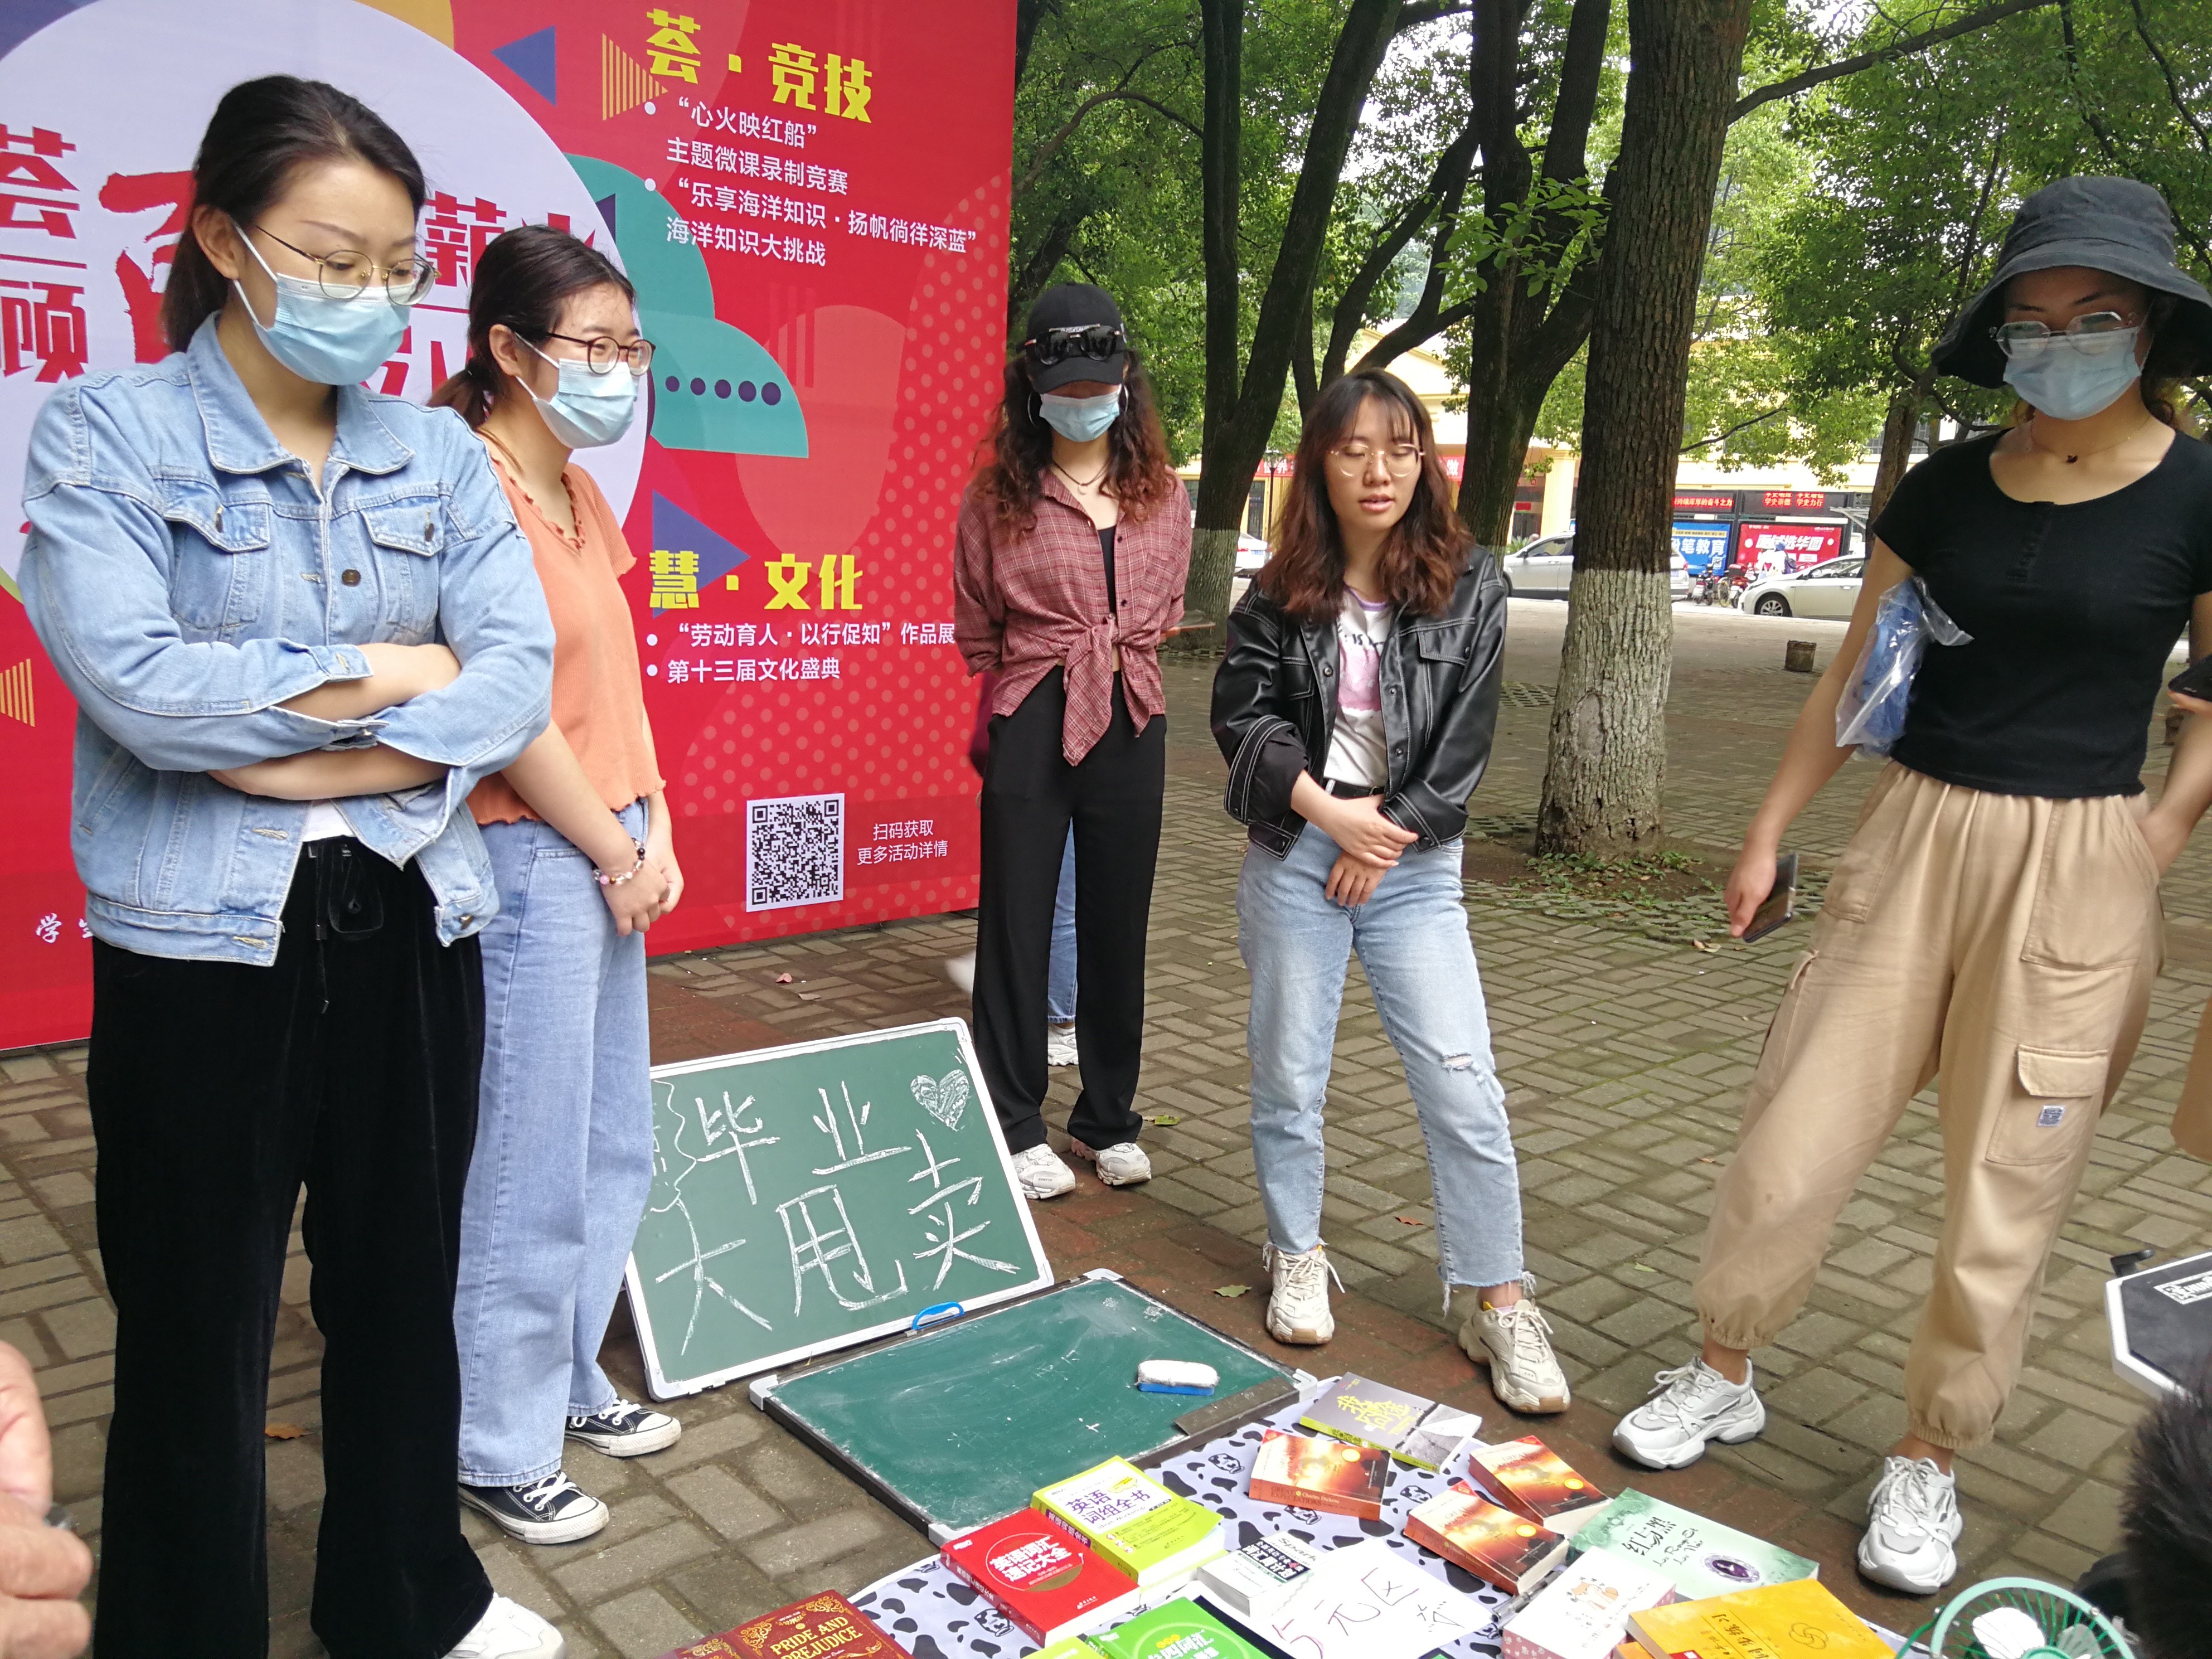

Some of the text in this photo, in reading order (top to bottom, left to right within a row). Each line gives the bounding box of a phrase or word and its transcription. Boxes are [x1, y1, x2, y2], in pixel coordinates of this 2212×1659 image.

[647, 8, 872, 123] 荟·竞技
[678, 97, 817, 149] “心火映红船”
[667, 137, 848, 195] 主题微课录制竞赛
[678, 177, 976, 253] “乐享海洋知识·扬帆徜徉深蓝”
[666, 217, 826, 266] 海洋知识大挑战
[649, 550, 864, 610] 慧·文化
[679, 622, 955, 647] “劳动育人·以行促知” 作品展
[667, 657, 841, 684] 第十三届文化盛典
[872, 819, 934, 841] 扫码获取
[857, 839, 948, 866] 更多活动详情
[695, 1080, 913, 1205] 毕业
[655, 1129, 1021, 1356] 大甩卖
[1064, 1489, 1112, 1515] 英语
[1082, 1489, 1151, 1525] 词组全书
[989, 1536, 1060, 1573] 英语词汇
[1278, 1537, 1318, 1562] Spark
[1622, 1516, 1677, 1556] 红与黑
[1002, 1546, 1072, 1582] 速记大全
[770, 1629, 818, 1655] PRIDE
[817, 1617, 848, 1635] AND
